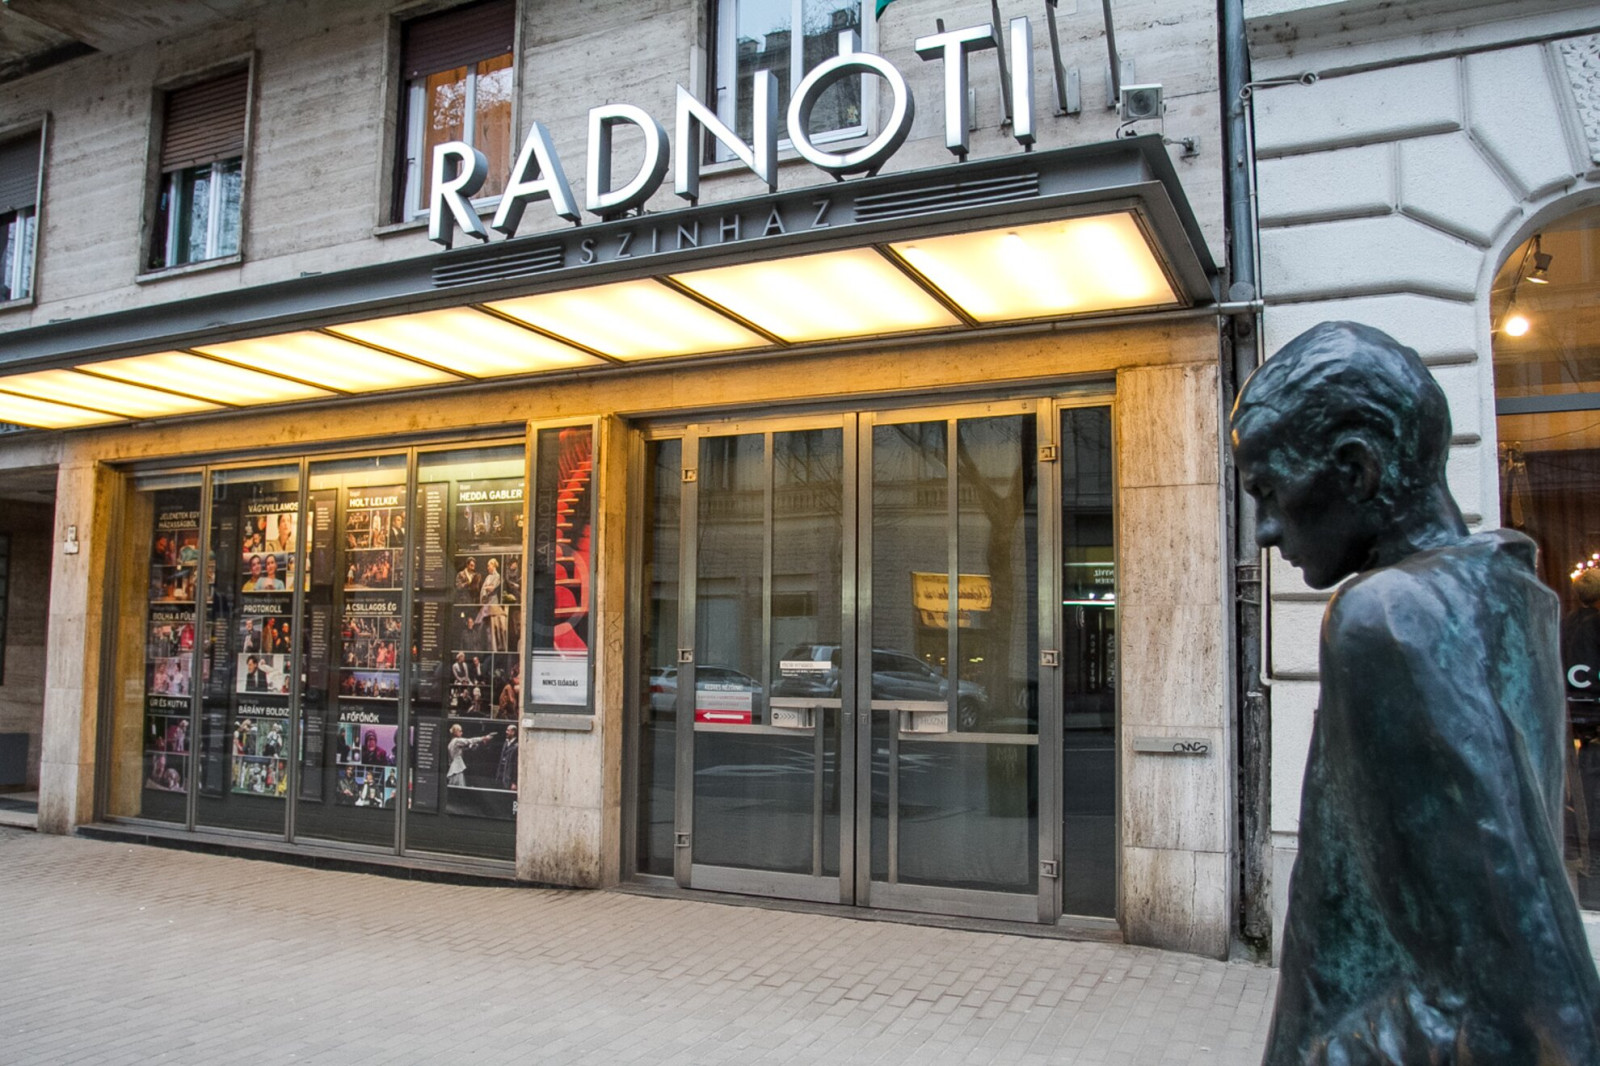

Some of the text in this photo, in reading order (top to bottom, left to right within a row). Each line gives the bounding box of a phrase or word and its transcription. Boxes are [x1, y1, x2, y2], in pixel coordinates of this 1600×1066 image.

[428, 16, 1036, 246] RADNÓTI
[459, 489, 523, 502] HEDDA GABLER
[349, 496, 398, 508] HOLT LELKEK
[243, 604, 283, 614] PROTOKOLL
[346, 601, 397, 611] A CSILLAGOS ÉG
[180, 611, 197, 621] FÜLB
[1567, 664, 1600, 688] C
[238, 704, 266, 715] BÁRÁNY
[340, 712, 346, 722] A
